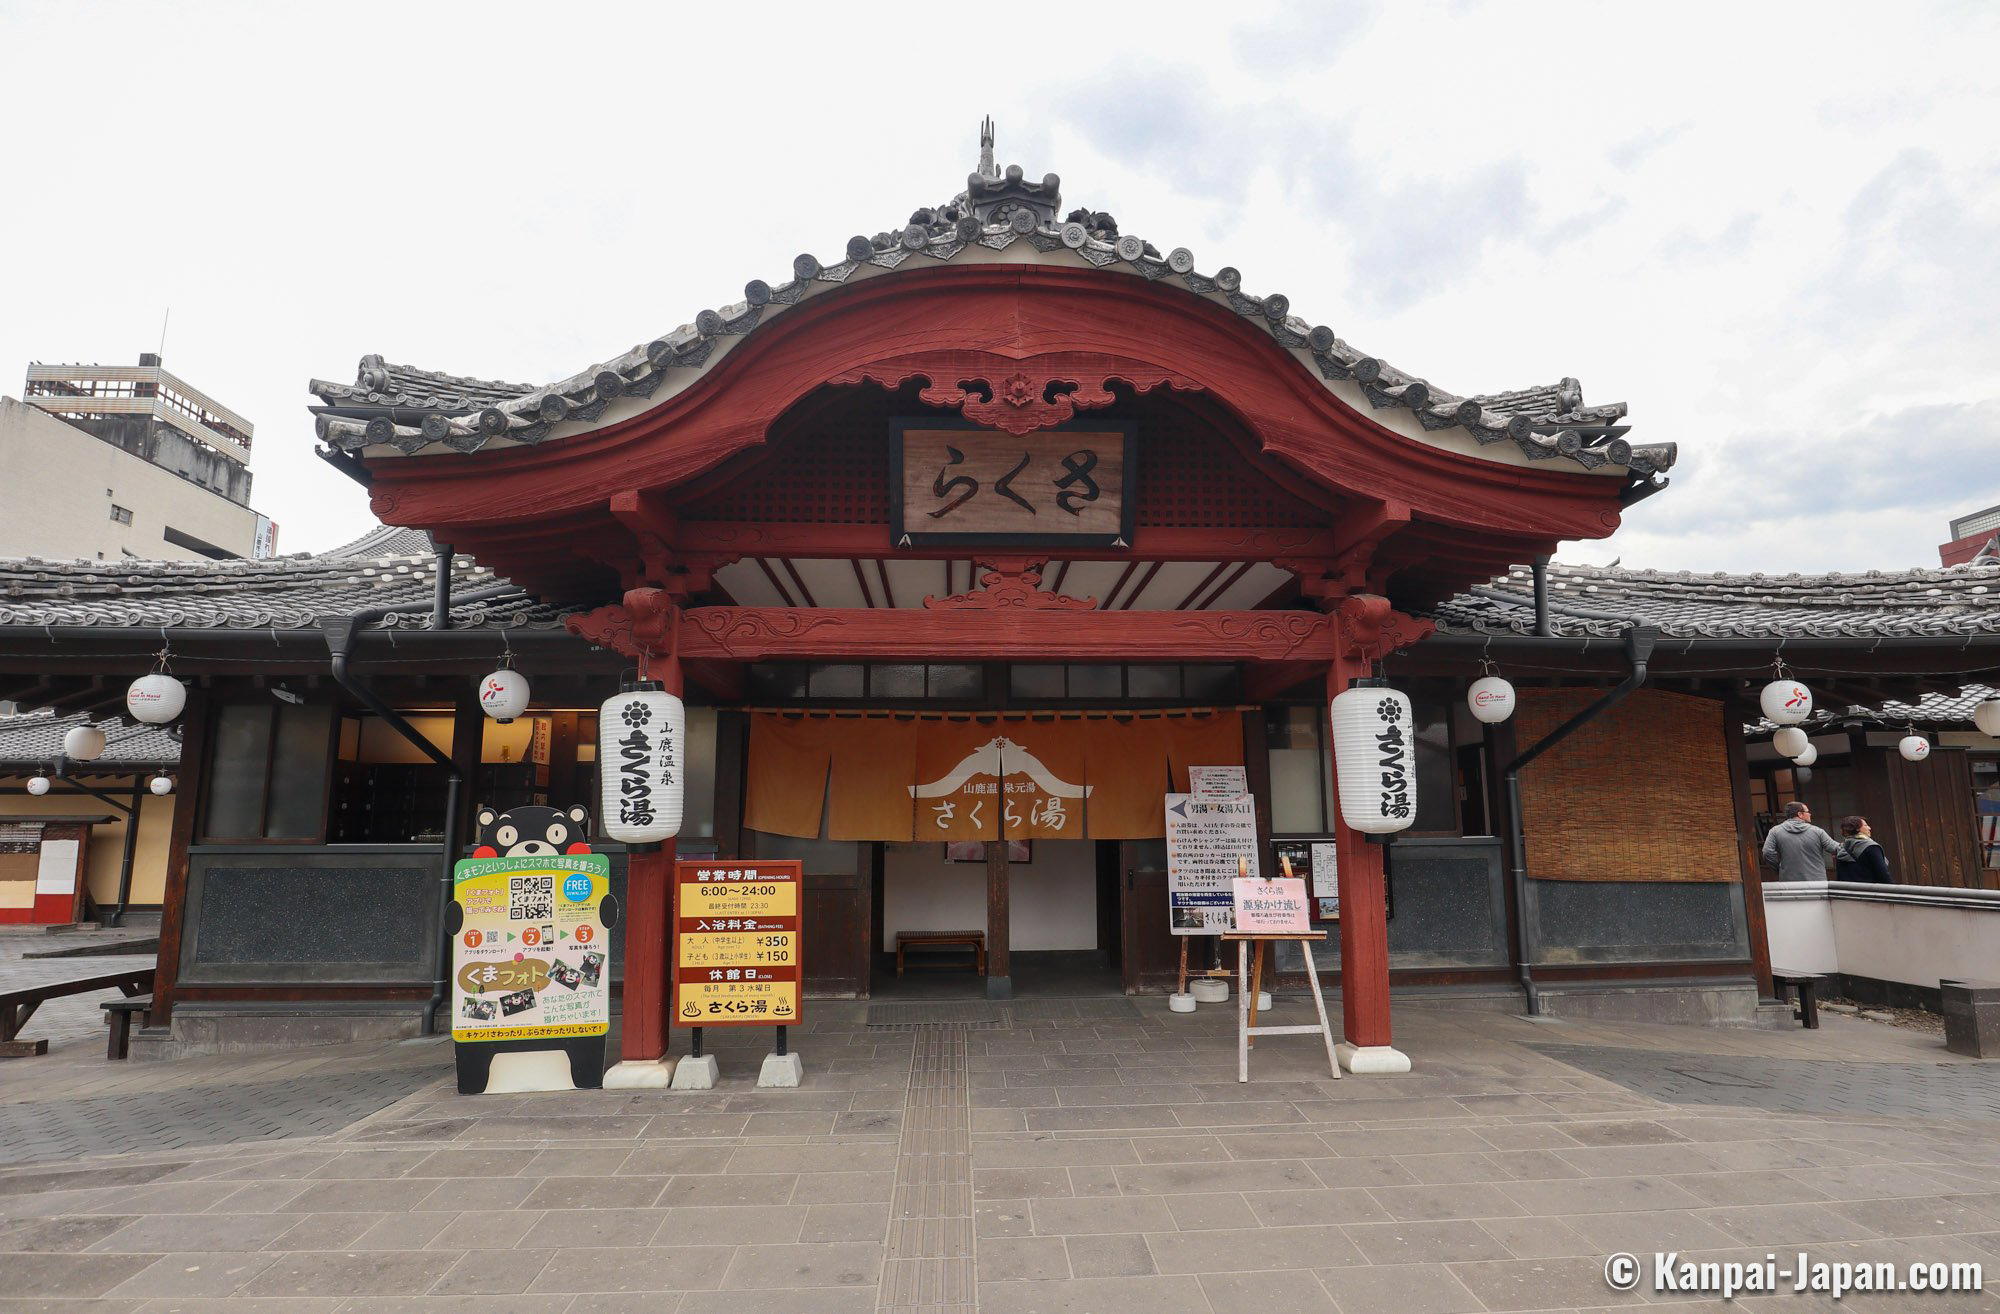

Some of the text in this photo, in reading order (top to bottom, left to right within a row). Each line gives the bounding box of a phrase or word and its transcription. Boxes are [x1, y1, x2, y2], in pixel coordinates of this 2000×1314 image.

[658, 722, 676, 786] 山鹿温泉
[1375, 724, 1411, 819] さくら湯
[618, 729, 657, 827] さくら湯
[931, 796, 1067, 831] さくら湯
[1191, 803, 1251, 814] 男湯・女湯入口
[697, 870, 758, 881] 営業時間
[566, 880, 588, 891] FREE
[701, 885, 776, 897] 6:00～24:00
[1257, 886, 1284, 895] さくら湯
[1243, 899, 1302, 910] 源泉かけ流し
[696, 919, 758, 931] 入浴料金
[470, 936, 476, 945] 1
[528, 934, 535, 944] 2
[581, 931, 588, 941] 3
[756, 935, 788, 947] ¥350
[756, 950, 788, 962] ¥150
[466, 965, 544, 986] くまフォト
[709, 969, 757, 980] 休館日
[704, 984, 719, 992] 毎月
[709, 999, 768, 1014] さくら湯
